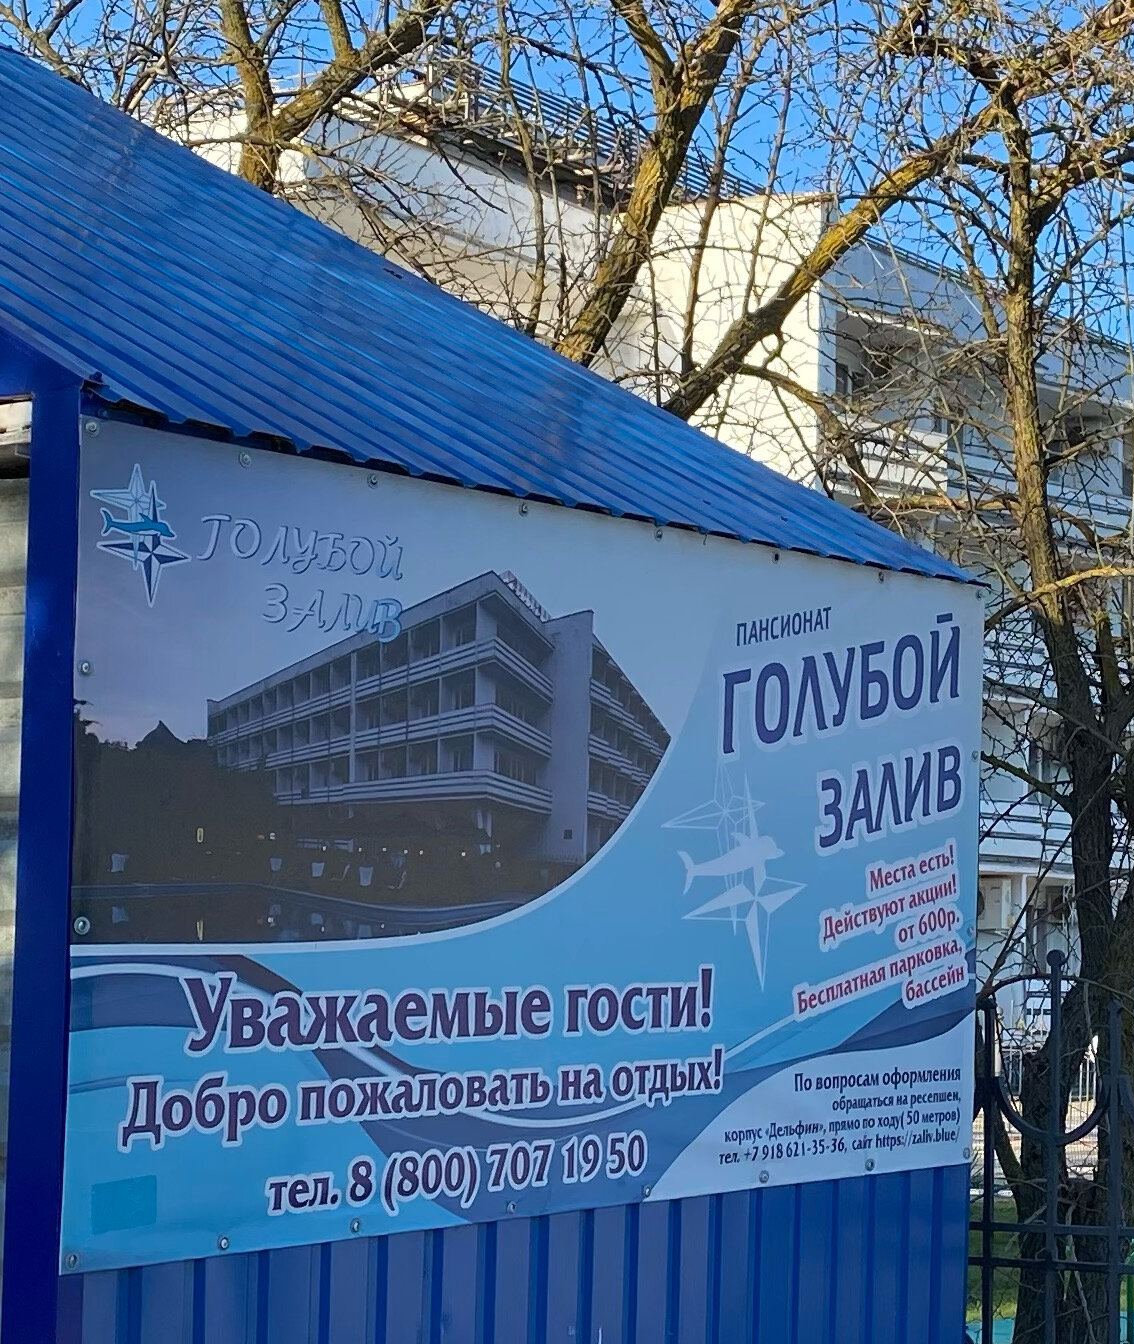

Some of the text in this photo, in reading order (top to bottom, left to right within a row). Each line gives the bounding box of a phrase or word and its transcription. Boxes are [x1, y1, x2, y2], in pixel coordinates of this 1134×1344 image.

[197, 514, 403, 580] ГОЛУБОЙ
[735, 606, 832, 647] ПАНСИОНАТ
[722, 612, 960, 754] ГОЛУБОЙ
[818, 745, 962, 849] ЗАЛИВ
[869, 844, 955, 892] Места есть!
[823, 873, 957, 945] Действуют акции!
[898, 907, 960, 943] от 600р.
[796, 939, 963, 1014] Бесплатная парковка,
[905, 964, 965, 1002] бассейн
[184, 967, 713, 1053] Уважаемые гости!
[122, 1048, 723, 1147] Добро пожаловать на отдых!
[794, 1066, 961, 1094] По вопросам оформления
[832, 1091, 961, 1114] обращаться на ресепшен,
[719, 1152, 740, 1165] тел.
[744, 1146, 759, 1161] +7
[762, 1143, 783, 1161] 918
[852, 1135, 872, 1151] сайт
[875, 1127, 960, 1151] https://zaliv.blue/
[724, 1127, 763, 1145] корпус
[765, 1120, 827, 1141] «Дельфин»,
[829, 1119, 860, 1135] прямо
[862, 1118, 875, 1129] по
[921, 1107, 960, 1126] метров)
[269, 1177, 339, 1212] тел.
[350, 1160, 373, 1202] 8
[386, 1146, 477, 1212] (800)
[489, 1143, 553, 1187] 707
